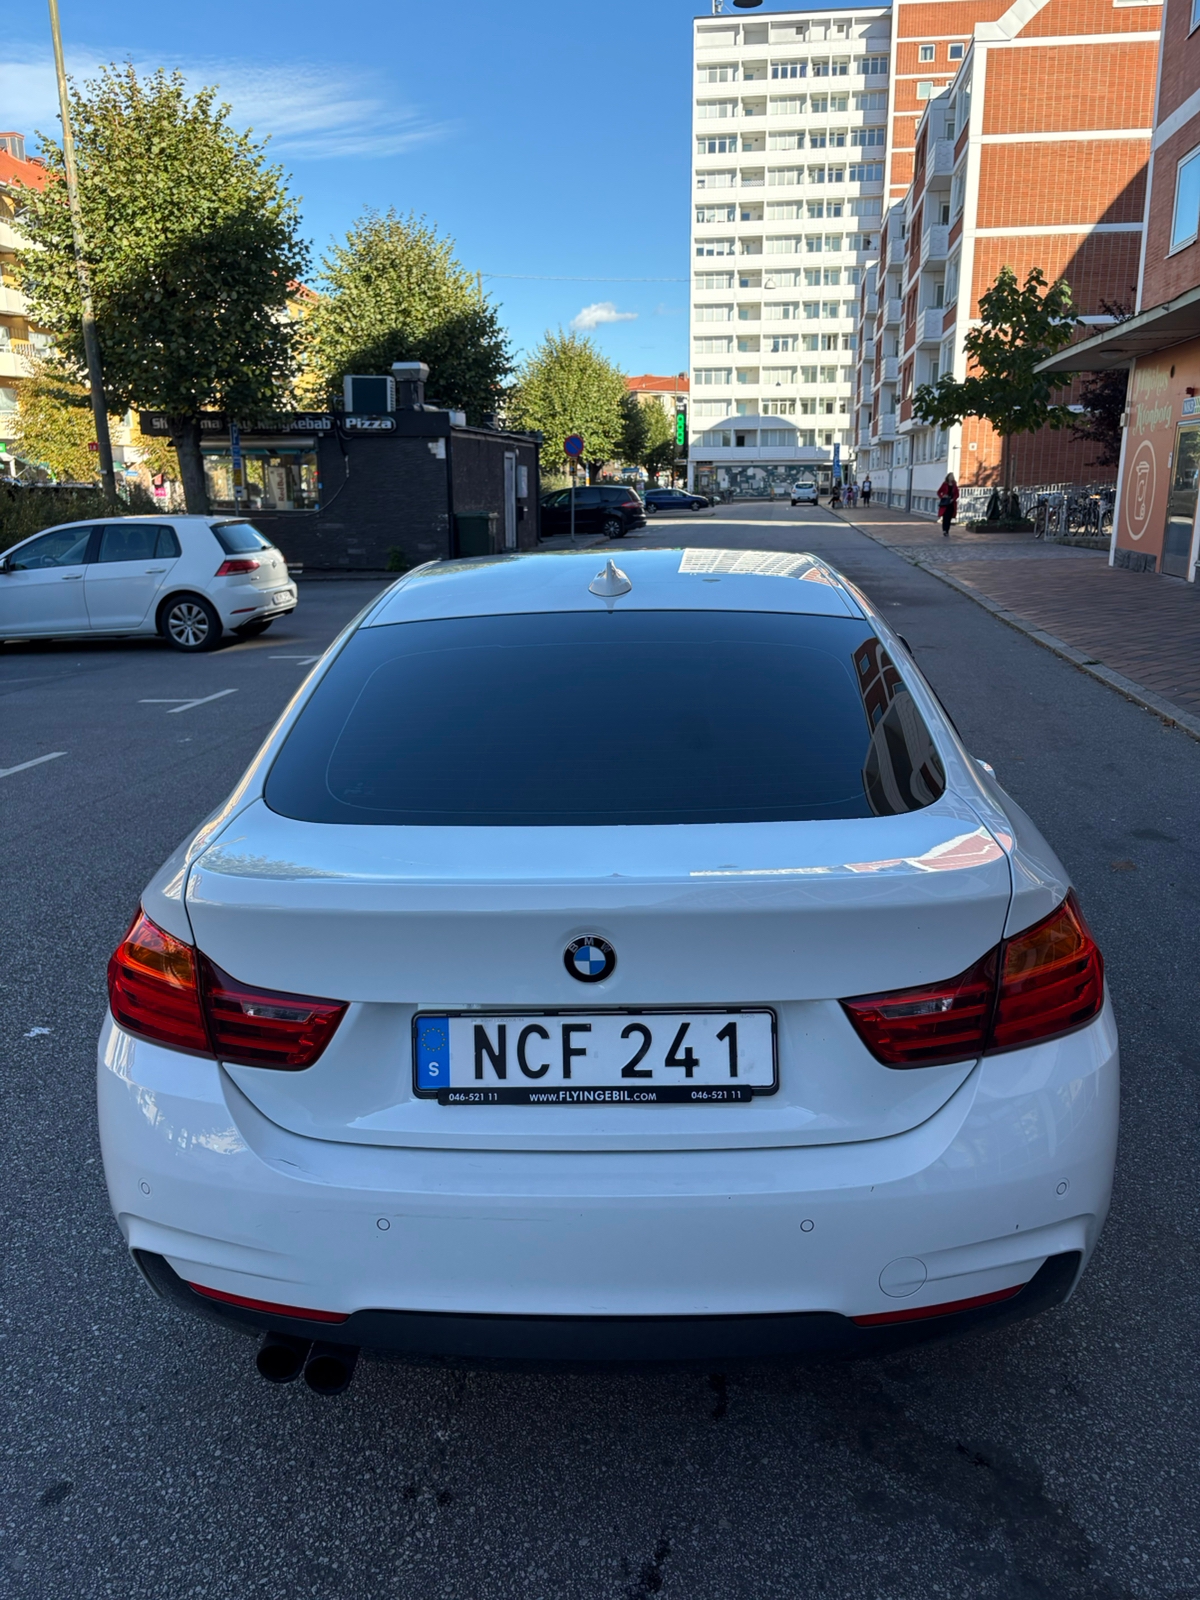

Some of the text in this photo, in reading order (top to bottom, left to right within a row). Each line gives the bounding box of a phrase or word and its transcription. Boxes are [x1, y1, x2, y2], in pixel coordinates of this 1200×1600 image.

[345, 418, 393, 429] Pizza
[568, 937, 612, 954] BMW
[474, 1021, 738, 1079] NCF 241
[428, 1062, 440, 1077] S
[448, 1092, 498, 1101] 046-521 11
[691, 1090, 741, 1099] 046-521 11
